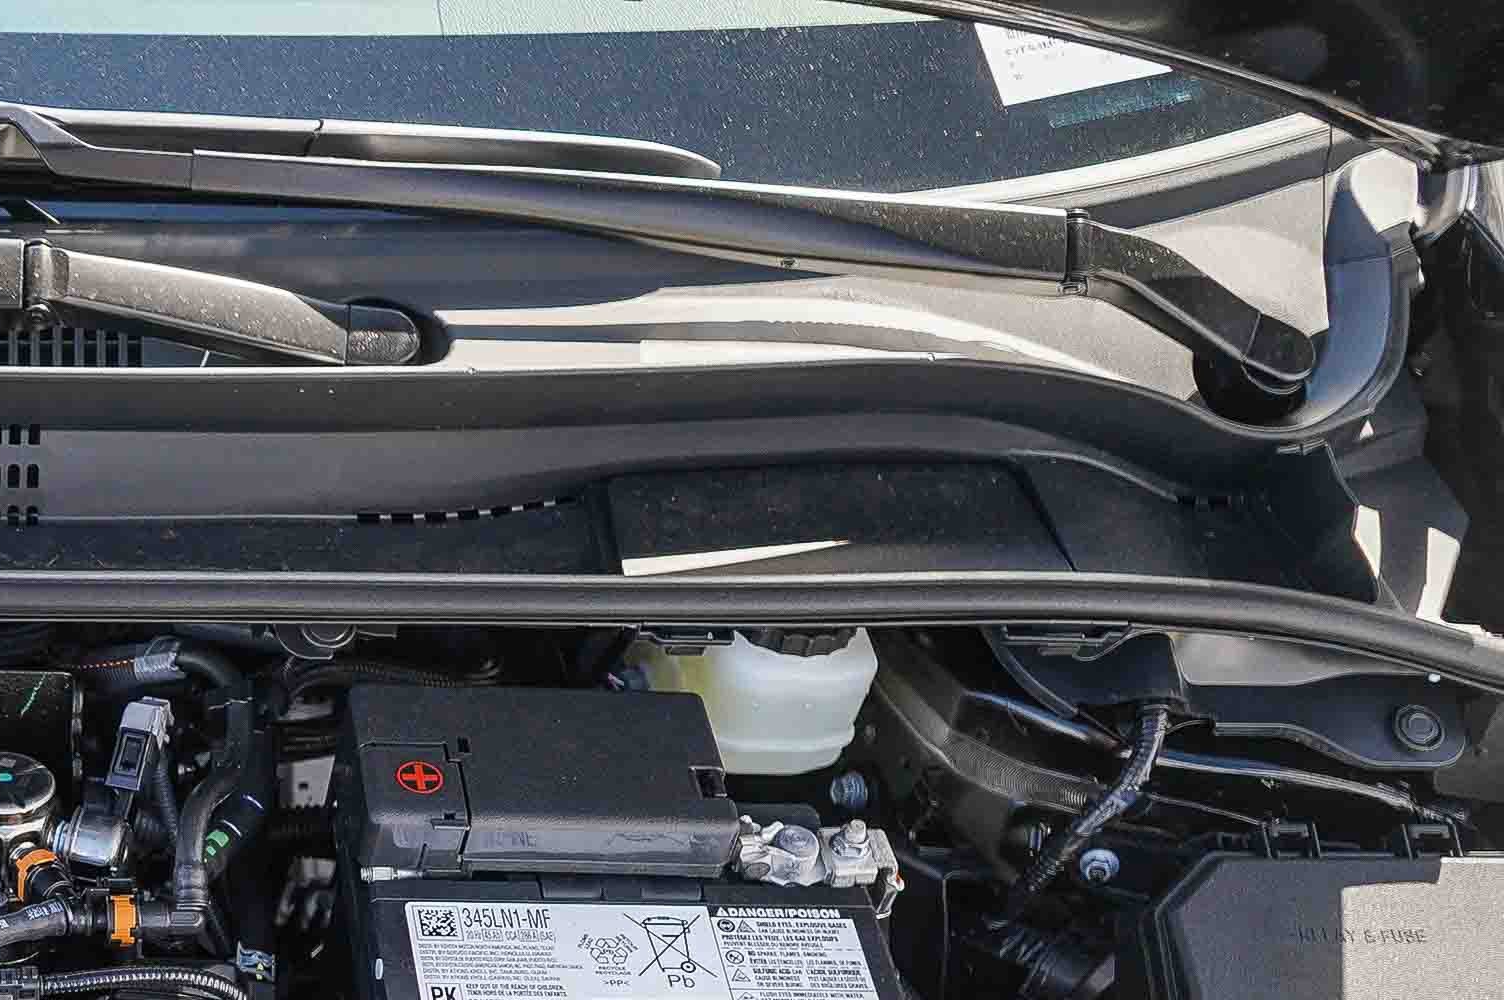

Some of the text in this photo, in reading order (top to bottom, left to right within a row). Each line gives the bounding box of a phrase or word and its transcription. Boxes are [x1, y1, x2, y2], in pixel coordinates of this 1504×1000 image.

[462, 907, 551, 929] 345LN1-MF
[727, 907, 841, 919] DANGER/POISON
[1380, 928, 1426, 944] FUSE
[668, 974, 696, 988] Pb
